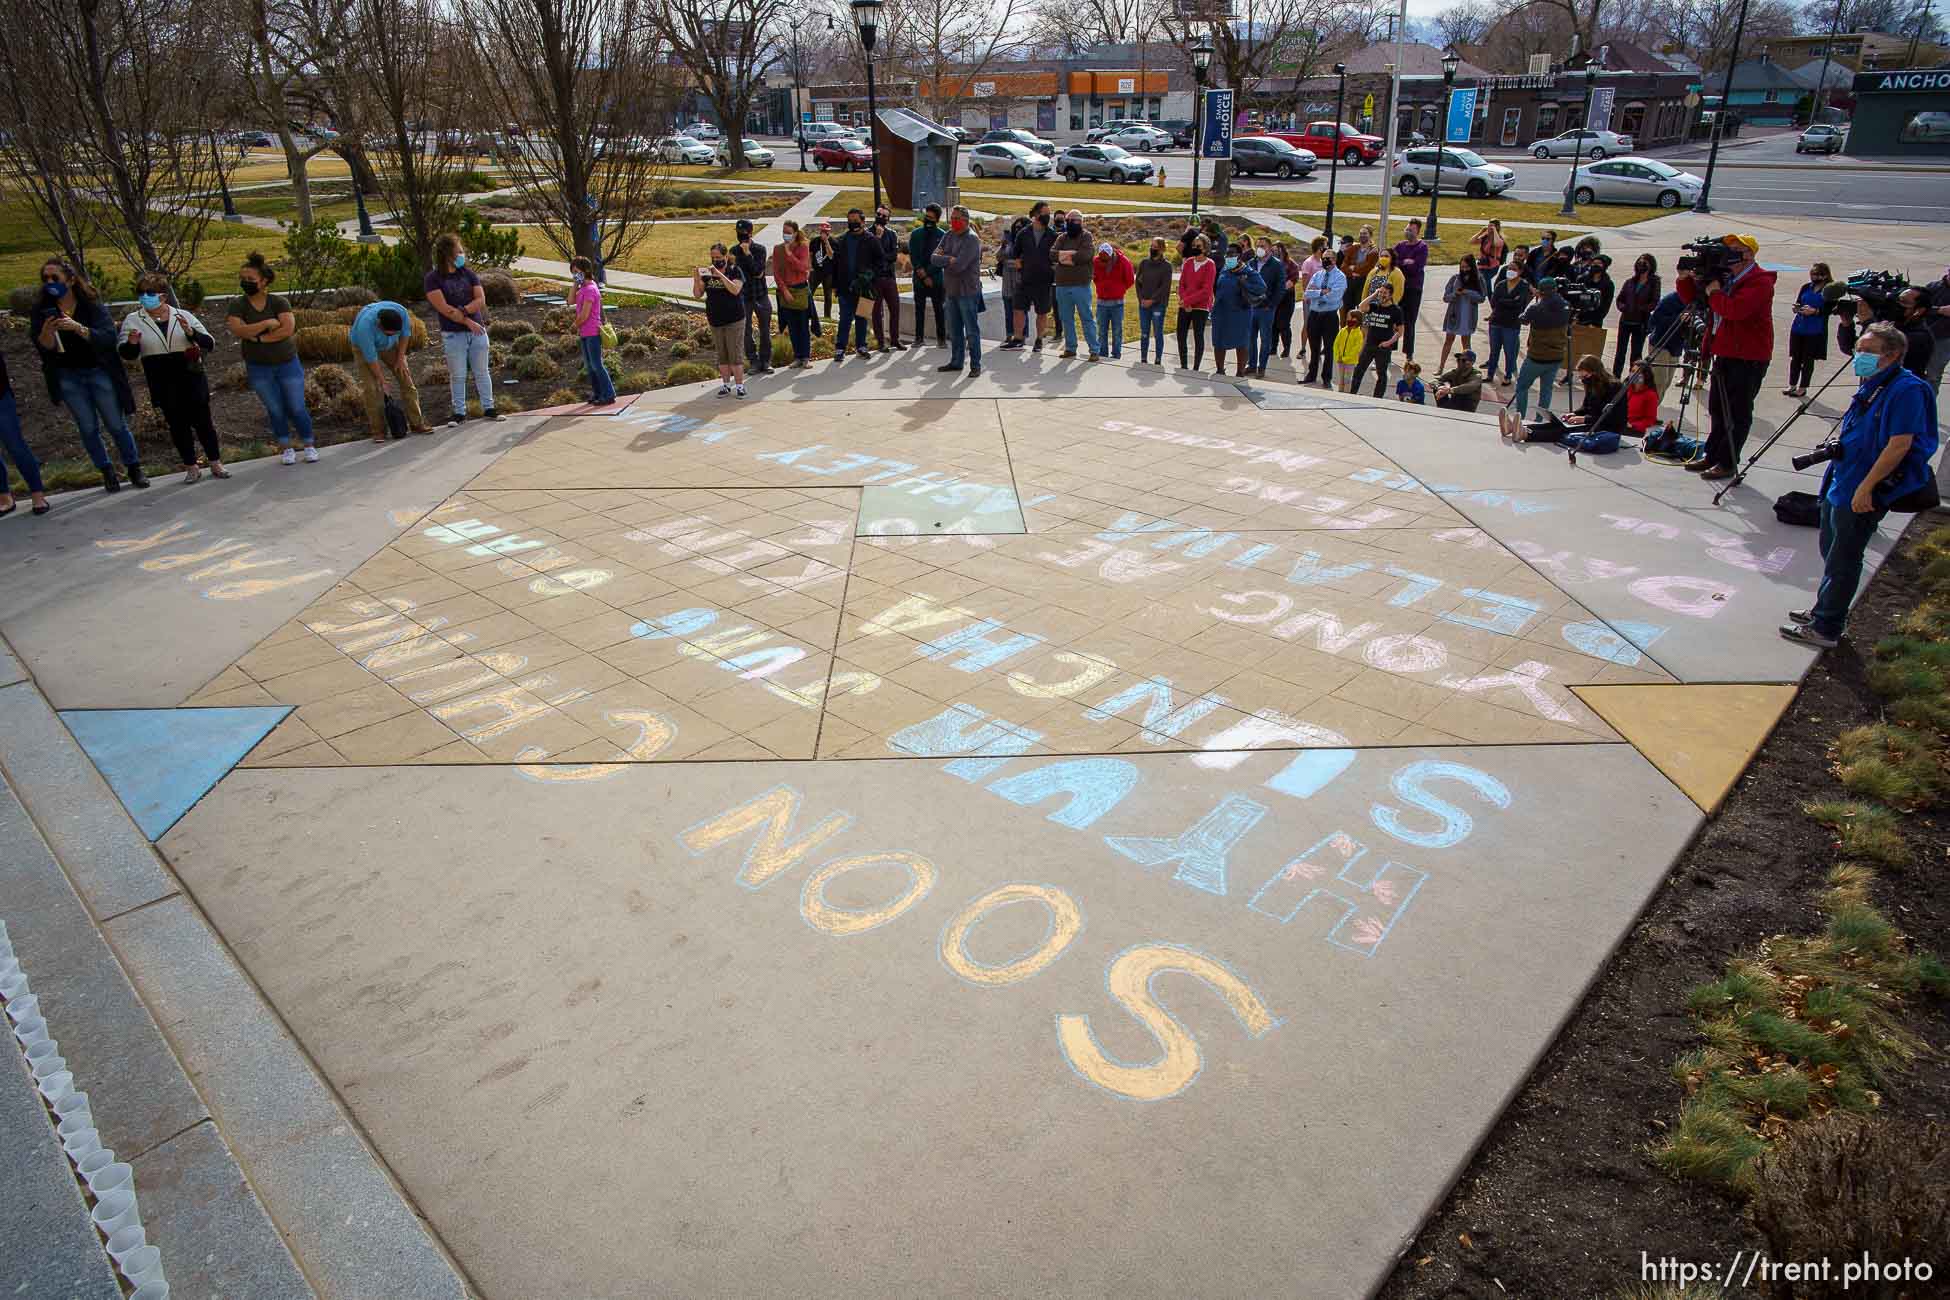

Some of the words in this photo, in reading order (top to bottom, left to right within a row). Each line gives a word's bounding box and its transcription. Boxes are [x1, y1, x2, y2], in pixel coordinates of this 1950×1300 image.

[1221, 93, 1231, 139] CHOICE
[1464, 91, 1475, 118] MOVE
[755, 444, 1057, 513] ASHLEY
[1098, 420, 1327, 472] MICHELS
[789, 515, 995, 548] YUE
[1217, 478, 1397, 530] FENG
[94, 520, 334, 600] PARK
[621, 516, 848, 598] KIM
[1034, 539, 1187, 583] AE
[1599, 513, 1797, 574] PAUL
[1096, 510, 1671, 667] DELAINA
[1196, 590, 1578, 725] YONG
[304, 598, 679, 784] CHUNG
[676, 782, 1284, 1101] SOON
